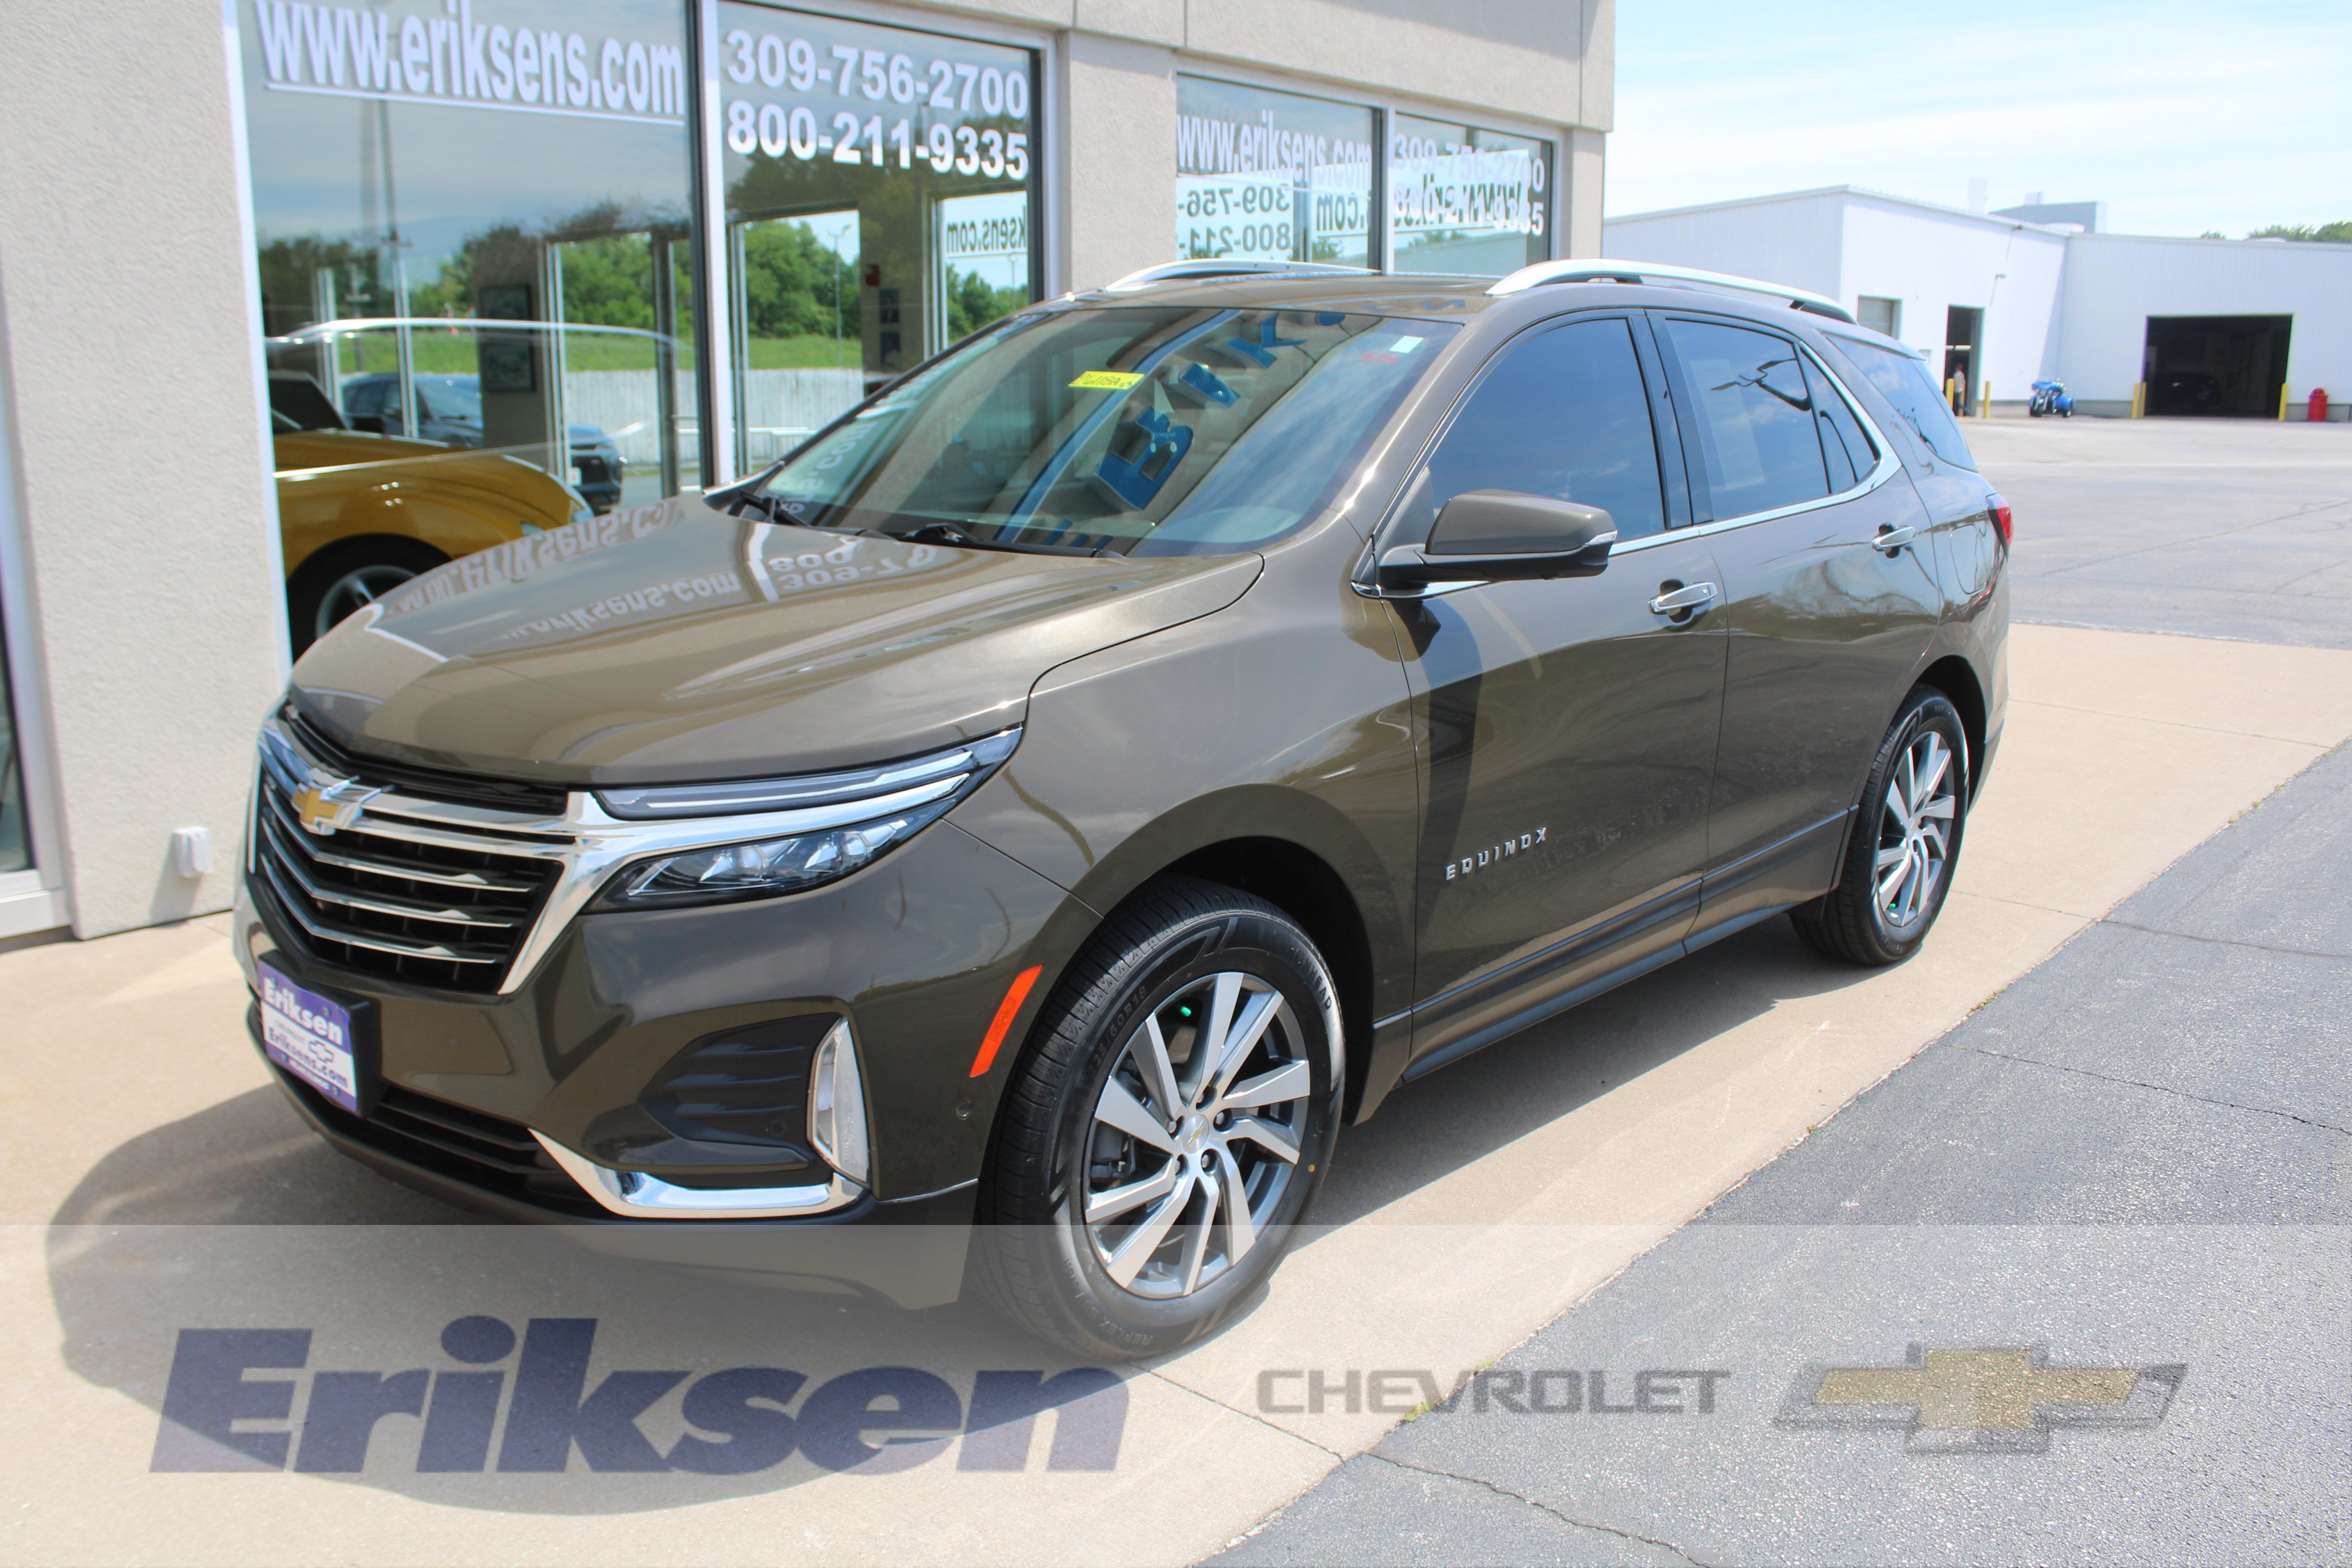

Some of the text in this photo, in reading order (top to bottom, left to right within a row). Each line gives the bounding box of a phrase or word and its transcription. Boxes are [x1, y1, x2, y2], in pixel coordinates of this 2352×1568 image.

[254, 0, 684, 115] www.eriksens.com
[726, 29, 1028, 119] 309-756-2700
[728, 100, 1028, 181] 800-211-9335
[1176, 109, 1372, 191] www.eriksens.com
[1394, 133, 1545, 193] 309-756-2700
[1445, 826, 1547, 881] EQUINOX
[263, 976, 343, 1047] Eriksen
